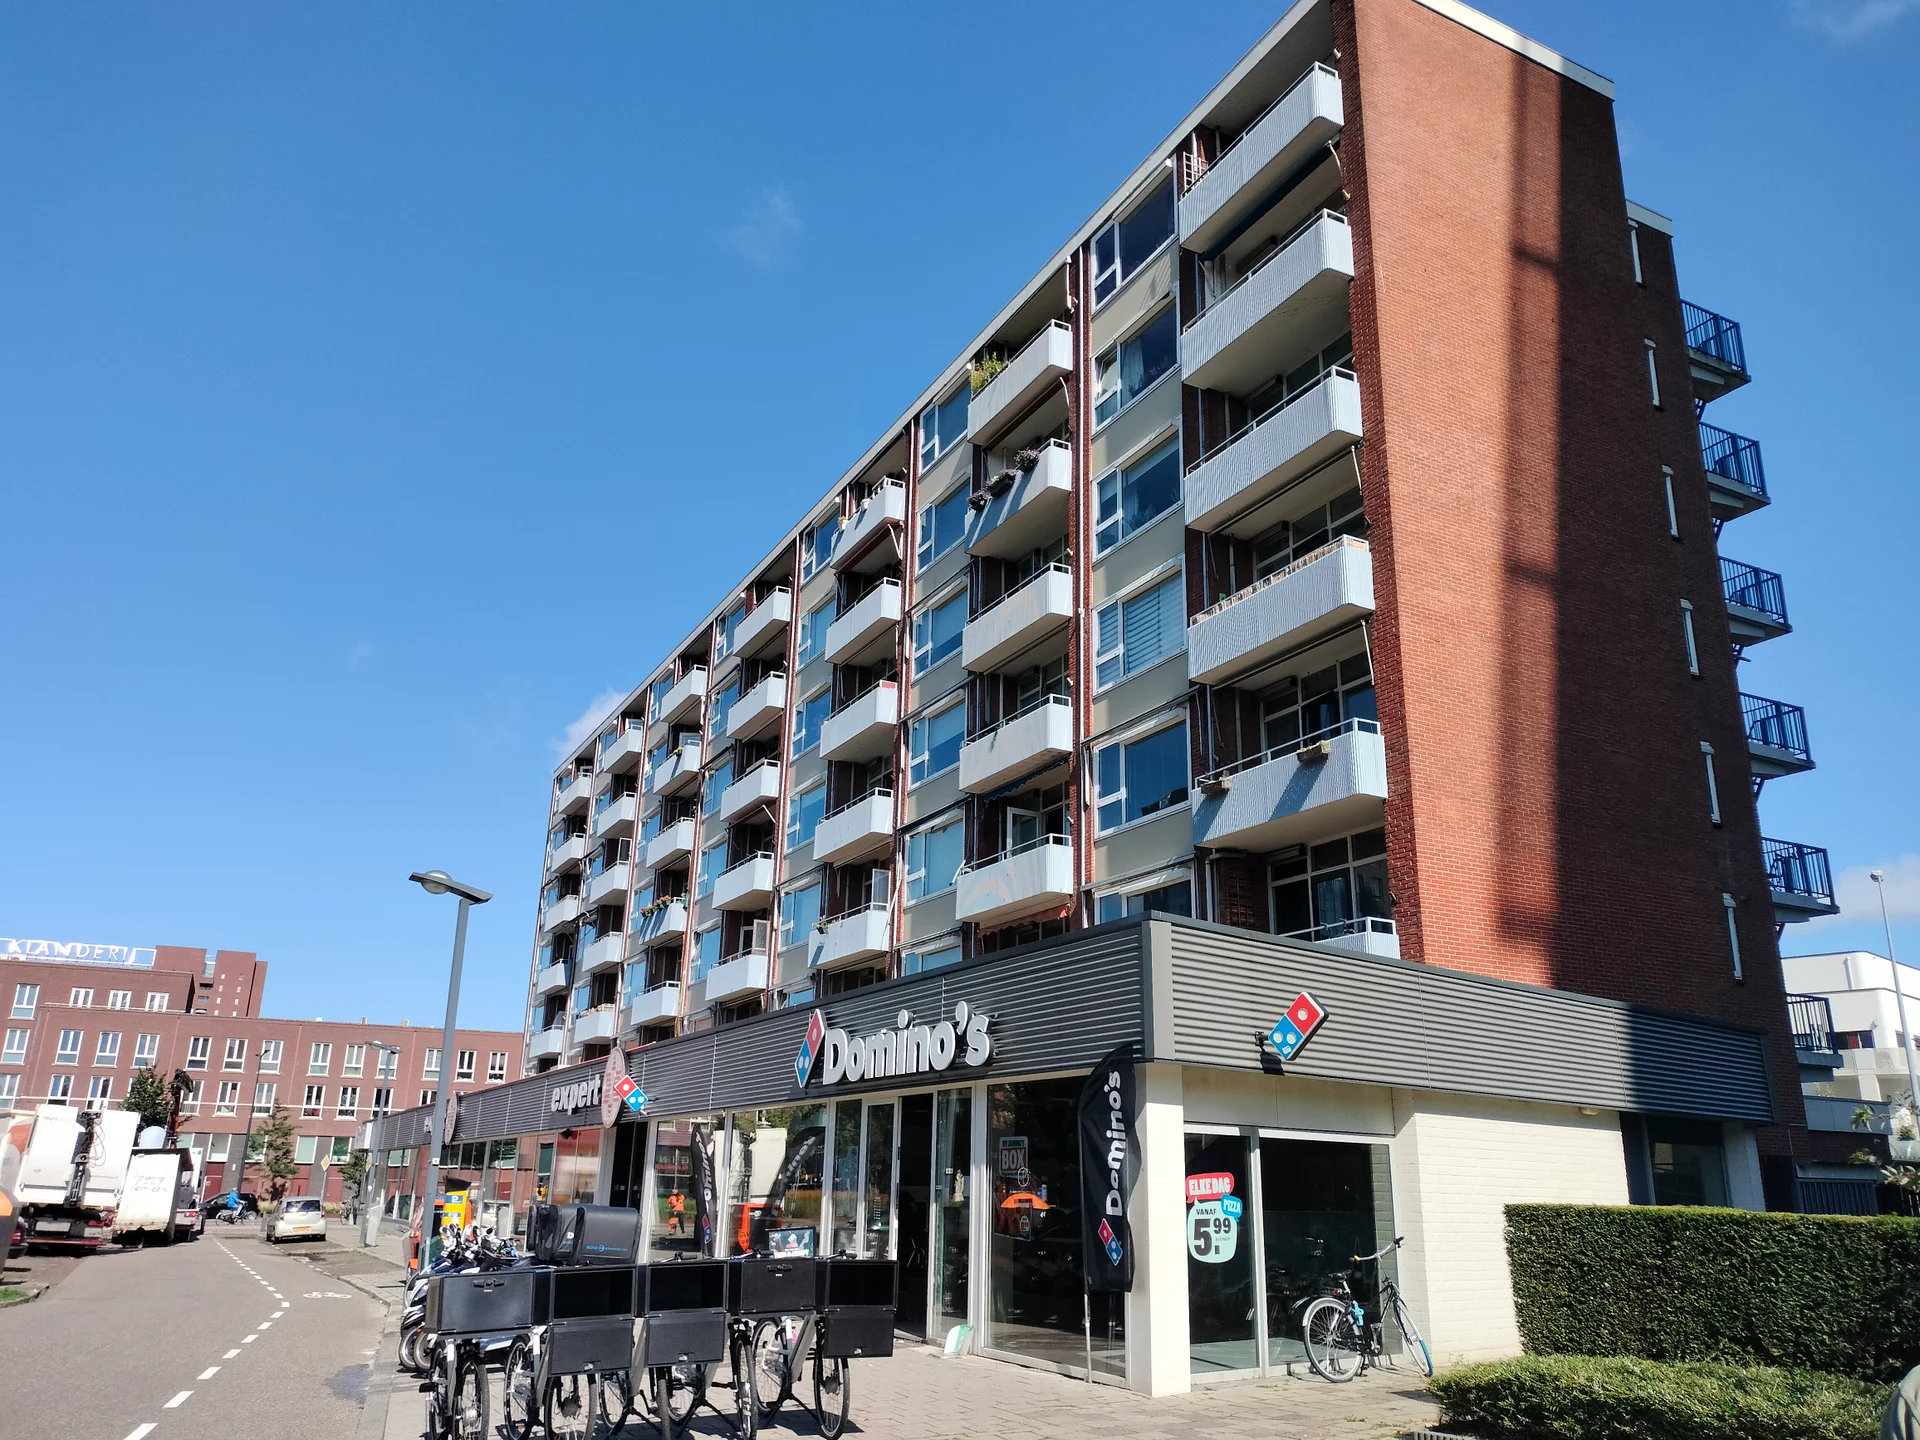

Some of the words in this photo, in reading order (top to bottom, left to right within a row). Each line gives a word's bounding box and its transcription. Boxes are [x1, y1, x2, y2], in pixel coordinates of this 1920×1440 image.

[823, 1001, 991, 1085] Domino's
[551, 1073, 602, 1115] expert
[1103, 1070, 1128, 1217] Domino's
[1002, 1149, 1025, 1170] BOX
[1188, 1178, 1212, 1196] ELKE
[1212, 1177, 1231, 1194] DAG
[1196, 1208, 1217, 1216] VANAF
[1223, 1198, 1241, 1214] PIZZA
